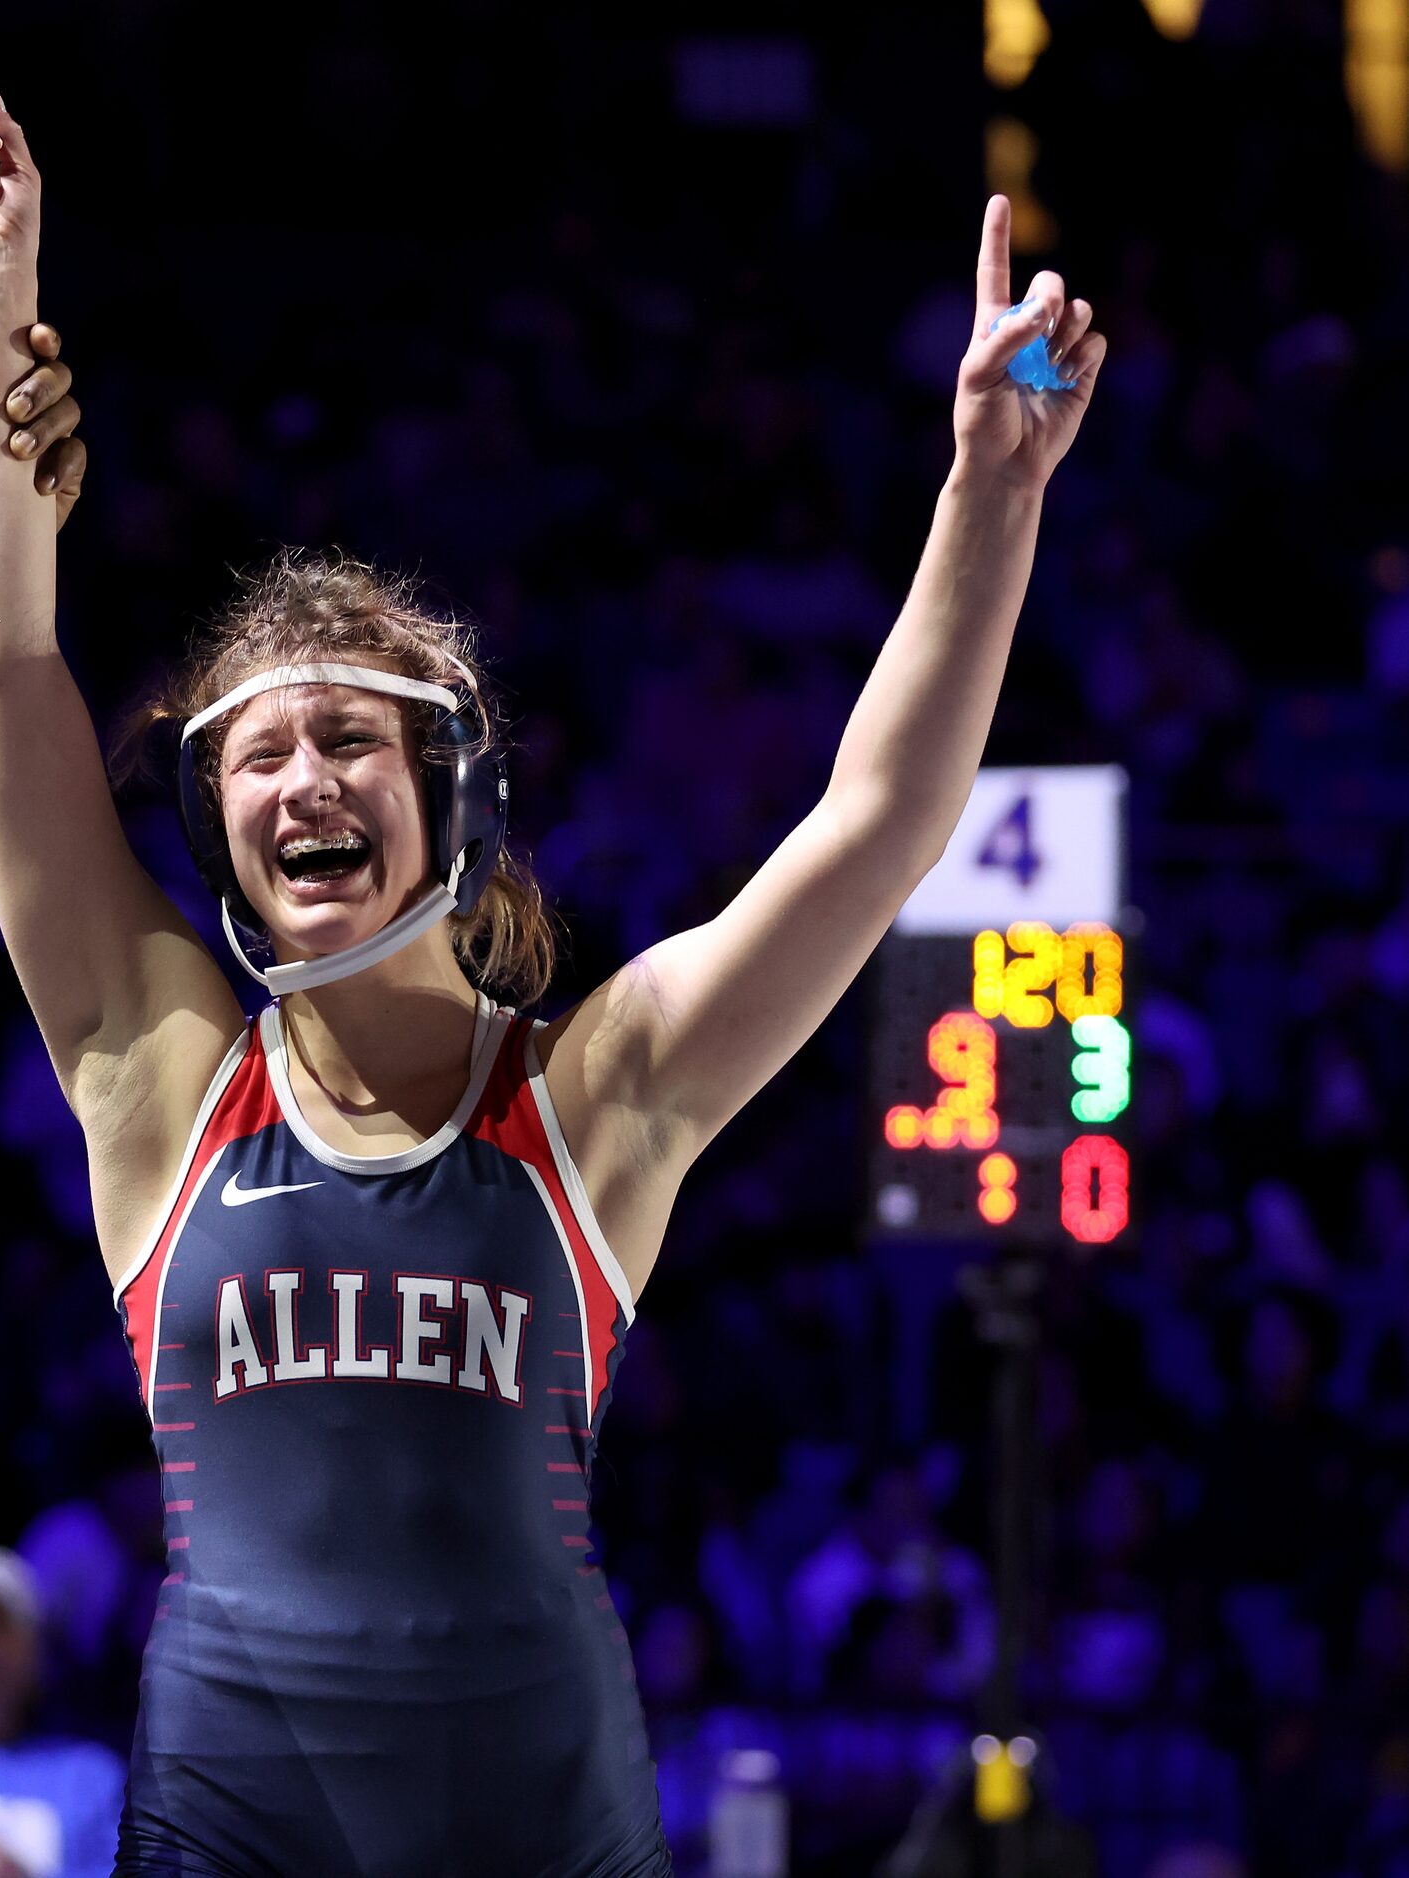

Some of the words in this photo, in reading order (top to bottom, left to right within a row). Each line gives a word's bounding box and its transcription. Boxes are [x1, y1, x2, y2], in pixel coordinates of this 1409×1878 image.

[976, 792, 1042, 887] 4
[973, 921, 1123, 1028] 120
[1071, 1014, 1131, 1123] 3
[212, 1267, 533, 1408] ALLEN
